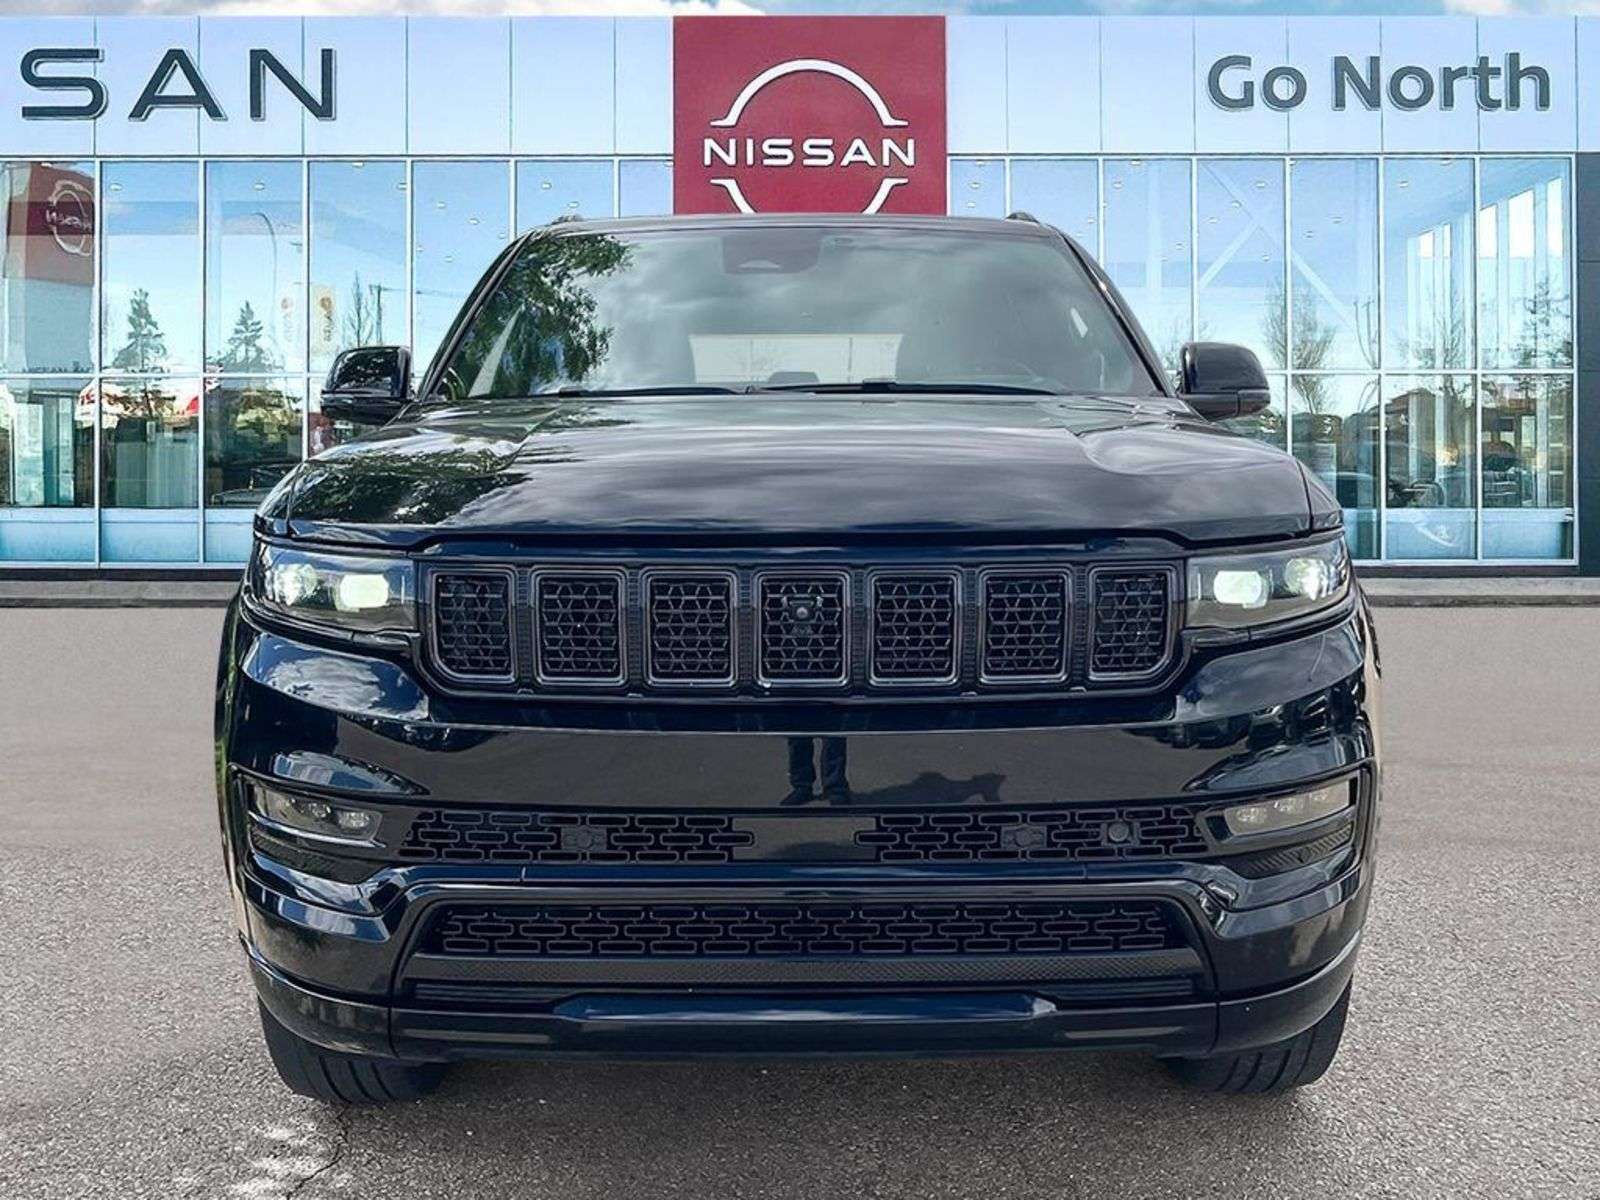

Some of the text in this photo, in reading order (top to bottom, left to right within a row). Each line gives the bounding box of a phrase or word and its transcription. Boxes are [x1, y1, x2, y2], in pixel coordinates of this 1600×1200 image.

[20, 47, 337, 121] SAN
[1207, 52, 1552, 111] Go North
[703, 138, 916, 168] NISSAN
